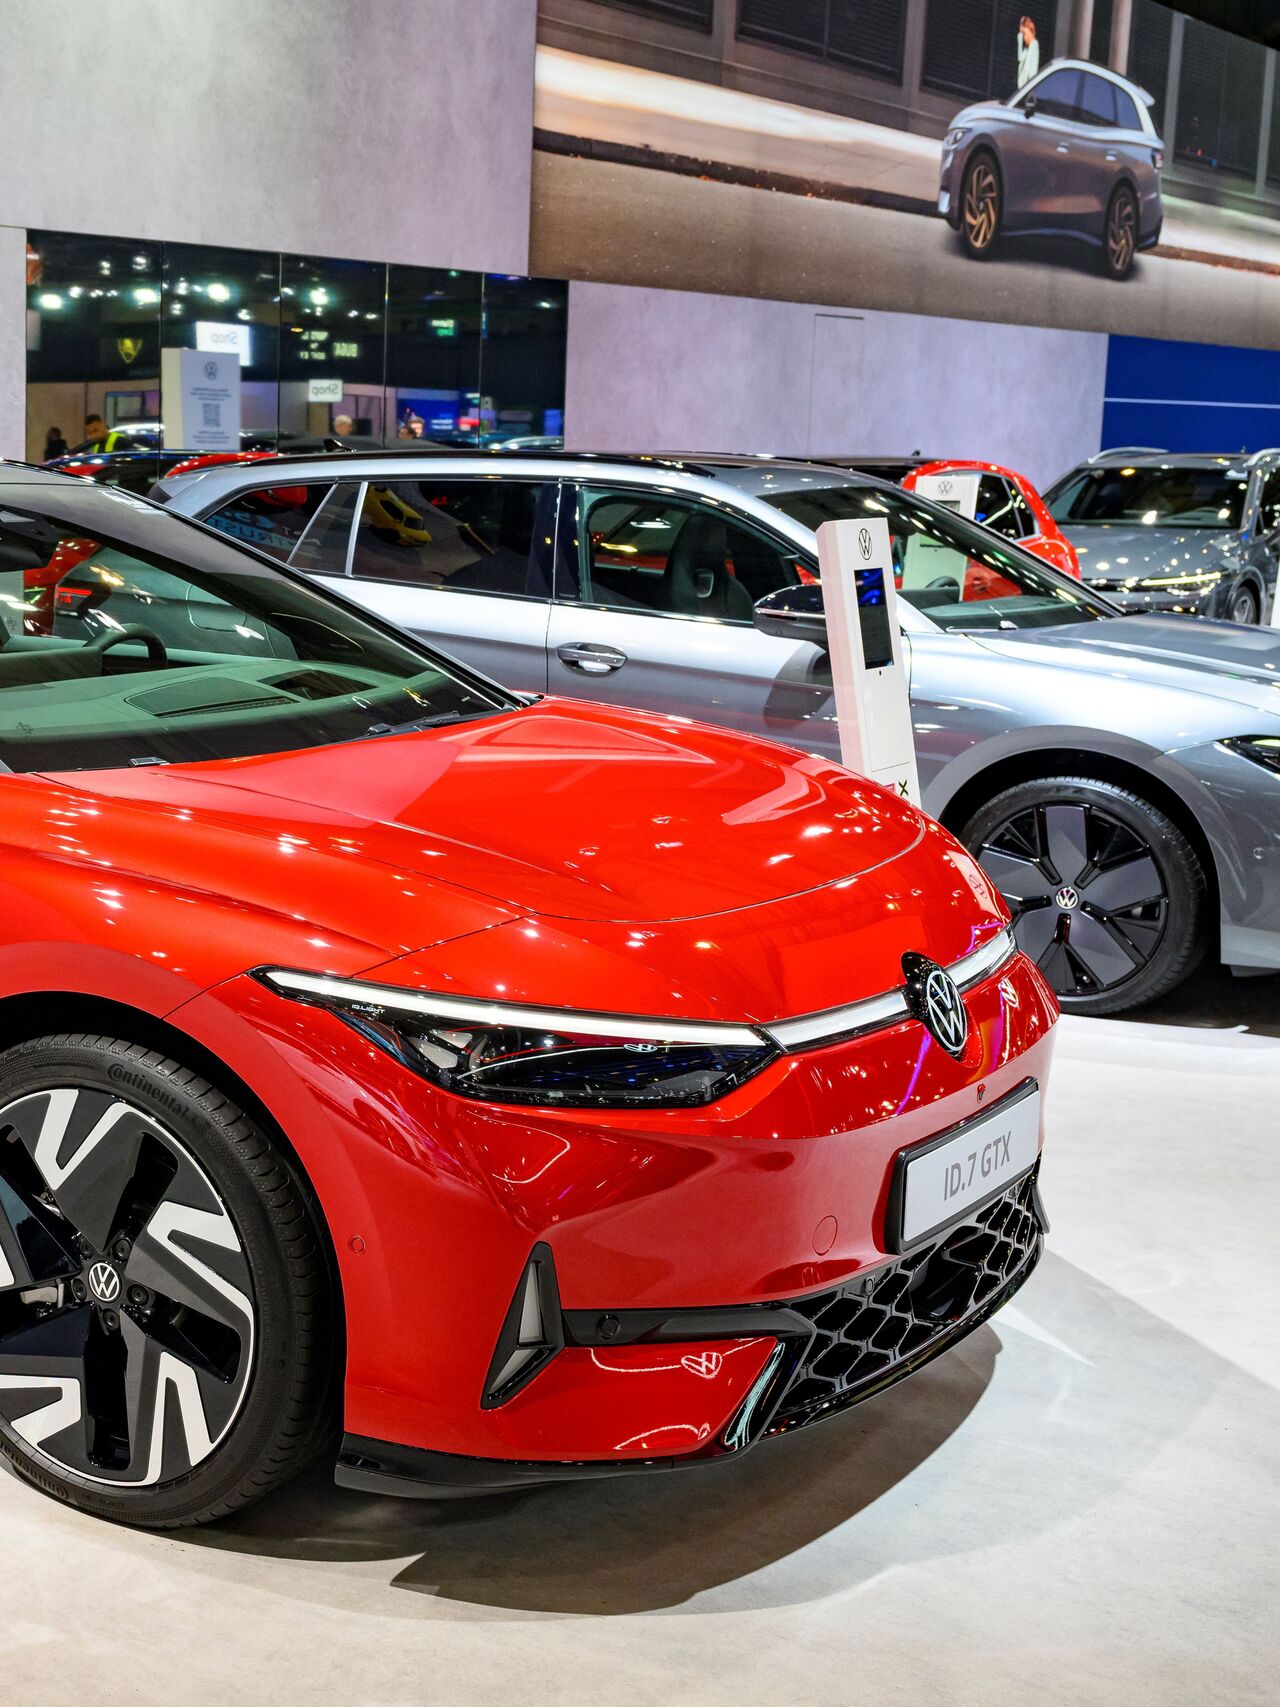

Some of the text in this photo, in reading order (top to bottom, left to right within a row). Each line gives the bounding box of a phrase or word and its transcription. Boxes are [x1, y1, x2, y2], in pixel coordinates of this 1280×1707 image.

[106, 1062, 190, 1121] Continental
[943, 1130, 1013, 1201] ID.7 GTX
